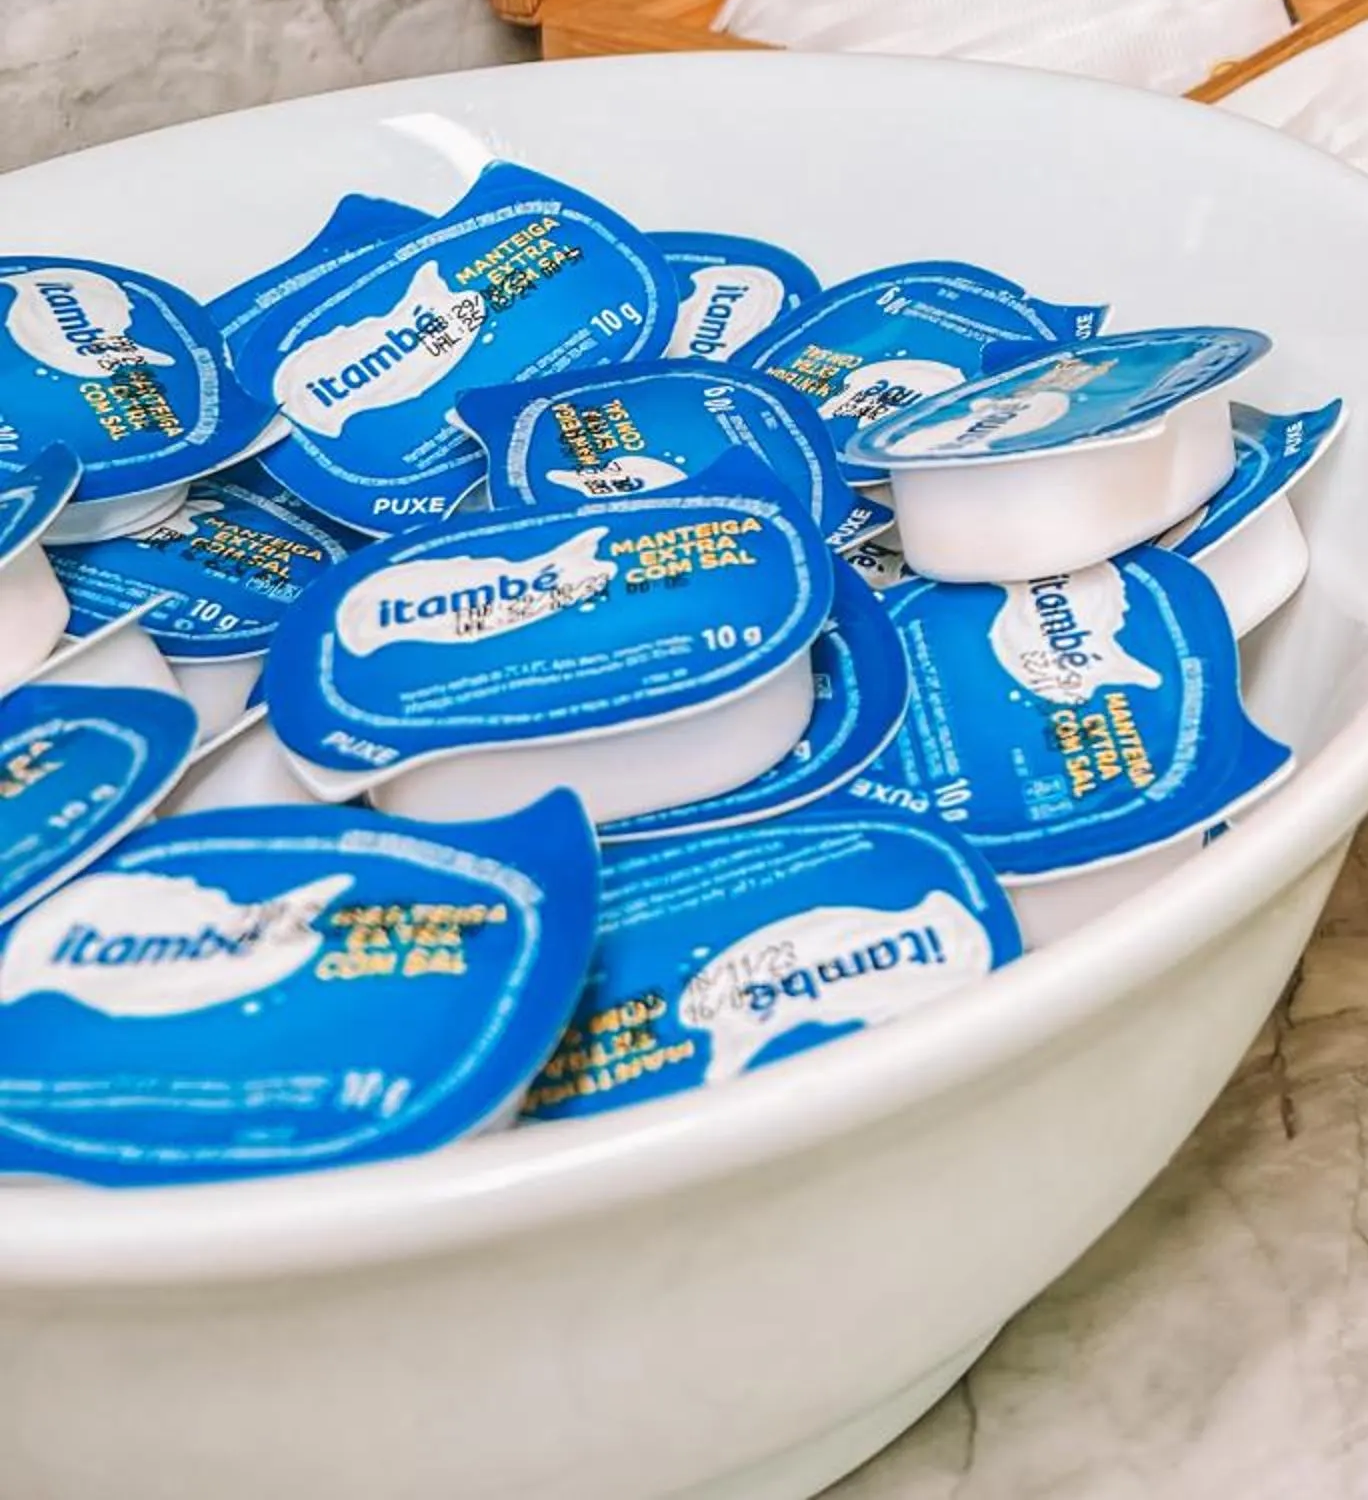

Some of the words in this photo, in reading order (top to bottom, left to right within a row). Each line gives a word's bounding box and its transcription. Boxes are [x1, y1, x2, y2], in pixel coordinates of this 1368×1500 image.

[455, 216, 561, 285] MANTEIGA
[487, 238, 556, 285] EXTRA
[591, 309, 622, 336] 10
[620, 302, 642, 326] g
[689, 283, 749, 358] itamb
[1075, 312, 1095, 340] UXE
[306, 305, 439, 407] itambé
[79, 382, 114, 416] COM
[615, 421, 646, 452] COM
[1283, 419, 1304, 458] PUXE
[374, 497, 446, 515] PUXE
[204, 516, 322, 562] MANTEIGA
[610, 517, 762, 557] MANTEIGA
[825, 507, 873, 546] PUXE
[190, 537, 246, 561] COM
[247, 554, 292, 579] SAL
[213, 531, 292, 563] EXTRA
[625, 558, 692, 583] COM
[700, 550, 757, 570] SAL
[639, 535, 737, 566] EXTRA
[379, 564, 561, 628] itambé
[190, 599, 223, 622] 10
[213, 616, 240, 633] g
[1028, 574, 1103, 670] itambé
[701, 625, 736, 651] 10
[743, 626, 762, 648] g
[321, 730, 398, 767] PUXE
[1052, 710, 1083, 755] COM
[1104, 692, 1155, 789] MANTEIGA
[848, 776, 930, 816] PUXE
[934, 778, 973, 808] 10
[1066, 756, 1097, 799] SAL
[315, 949, 398, 981] COM
[403, 947, 467, 977] SAL
[744, 926, 948, 1024] itambé
